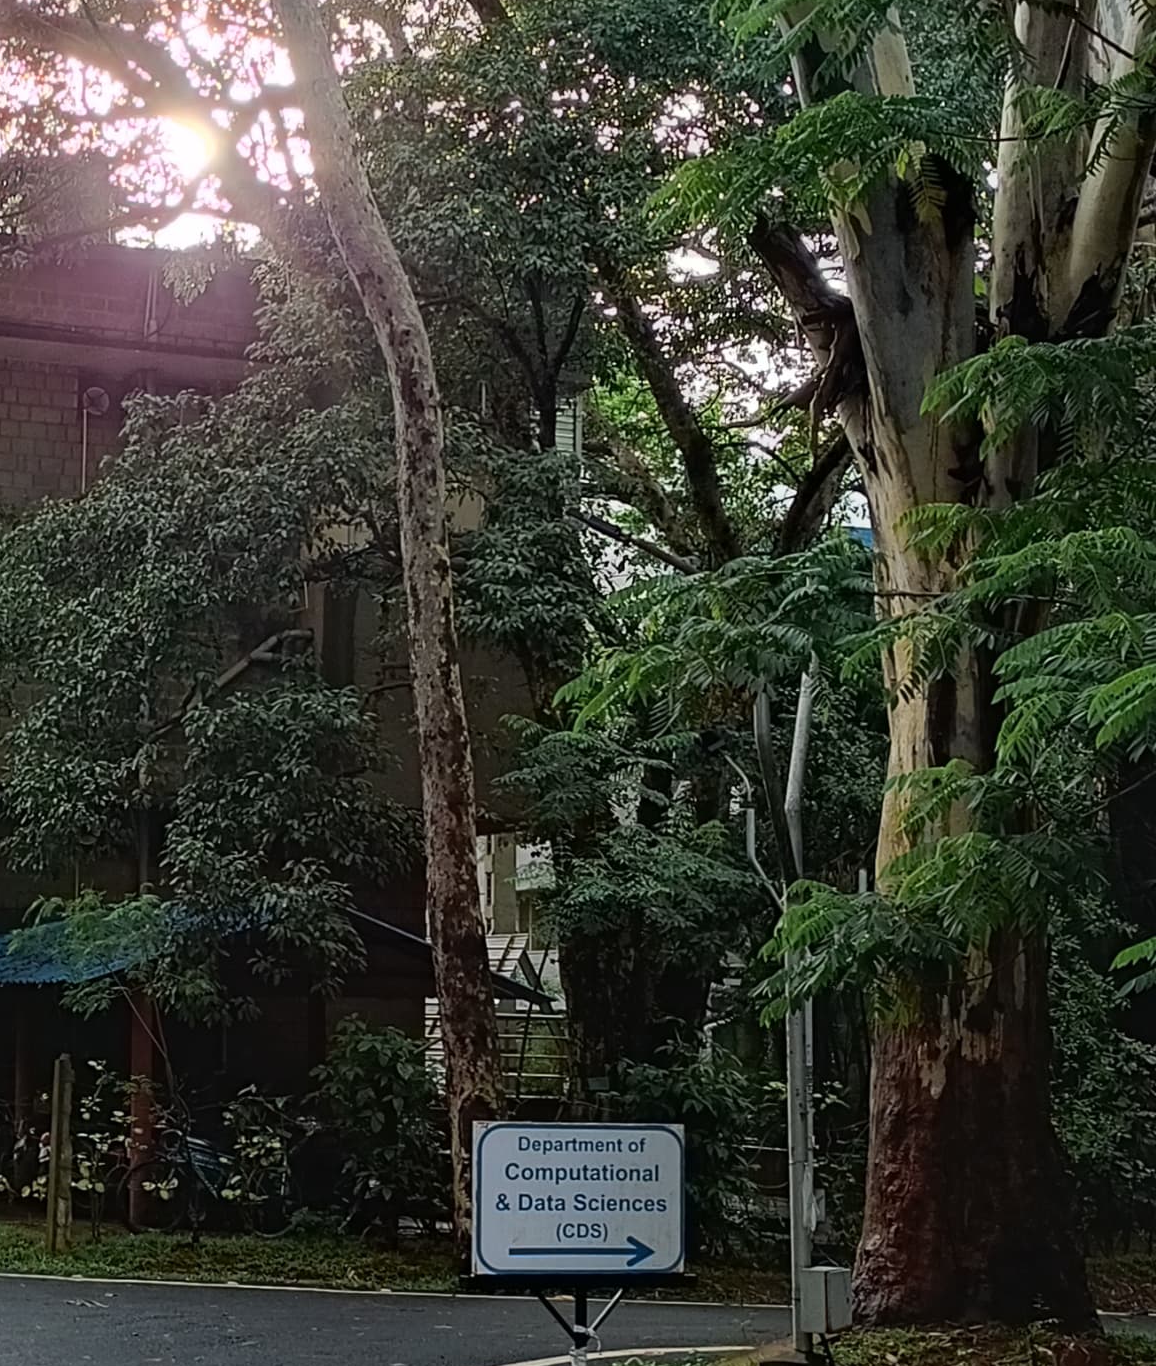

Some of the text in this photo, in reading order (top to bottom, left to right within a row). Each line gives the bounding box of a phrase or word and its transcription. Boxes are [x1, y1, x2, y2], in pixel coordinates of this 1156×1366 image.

[518, 1136, 646, 1155] Department of
[505, 1163, 660, 1184] Computational
[496, 1193, 667, 1212] & Data Sciences
[556, 1223, 609, 1242] (CDS)
